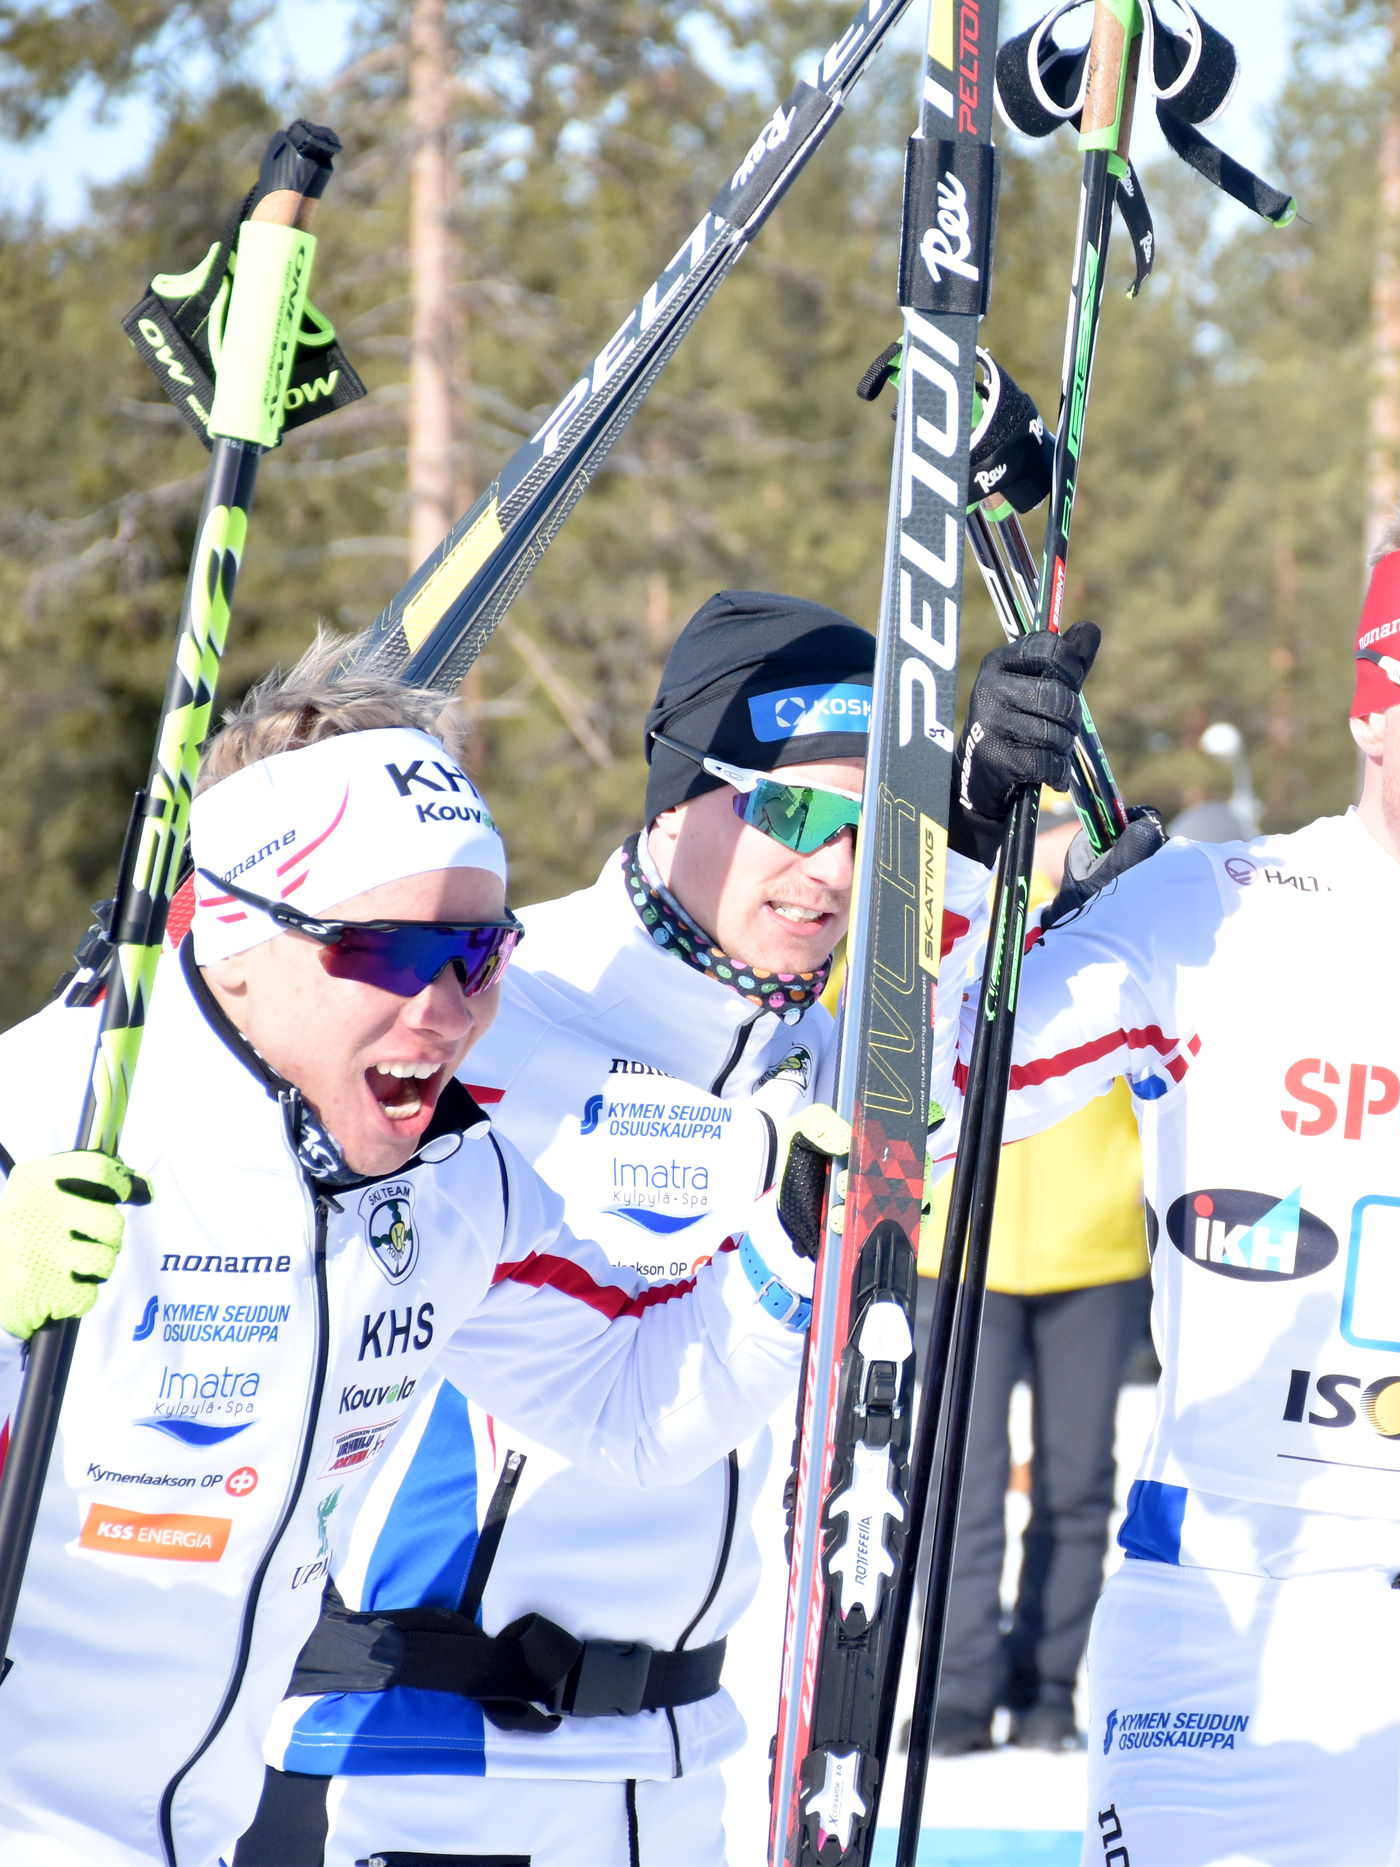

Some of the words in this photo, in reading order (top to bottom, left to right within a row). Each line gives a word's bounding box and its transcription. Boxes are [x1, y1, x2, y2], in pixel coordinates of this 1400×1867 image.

[920, 171, 979, 283] Rex
[973, 463, 1008, 494] Rex
[925, 827, 935, 962] SKATING
[608, 1102, 665, 1119] KYMEN
[668, 1105, 732, 1123] SEUDUN
[609, 1120, 722, 1140] OSUUSKAUPPA
[613, 1157, 708, 1190] Imatra
[380, 1186, 410, 1198] TEAM
[682, 1191, 708, 1208] Spa
[161, 1254, 291, 1274] noname
[669, 1262, 687, 1276] OP
[163, 1304, 218, 1323] KYMEN
[224, 1304, 290, 1323] SEUDUN
[163, 1323, 278, 1343] OSUUSKAUPPA
[358, 1302, 434, 1361] KHS
[160, 1366, 260, 1400] Imatra
[339, 1375, 414, 1415] Kouvola
[226, 1402, 254, 1418] Spa
[337, 1434, 376, 1458] URHEILU
[87, 1463, 196, 1488] Kymenlaakson
[200, 1475, 224, 1488] OP
[97, 1521, 134, 1540] KSS
[137, 1527, 212, 1549] ENERGIA
[1173, 1712, 1250, 1733] SEUDUN
[1118, 1731, 1236, 1751] OSUUSKAUPPA
